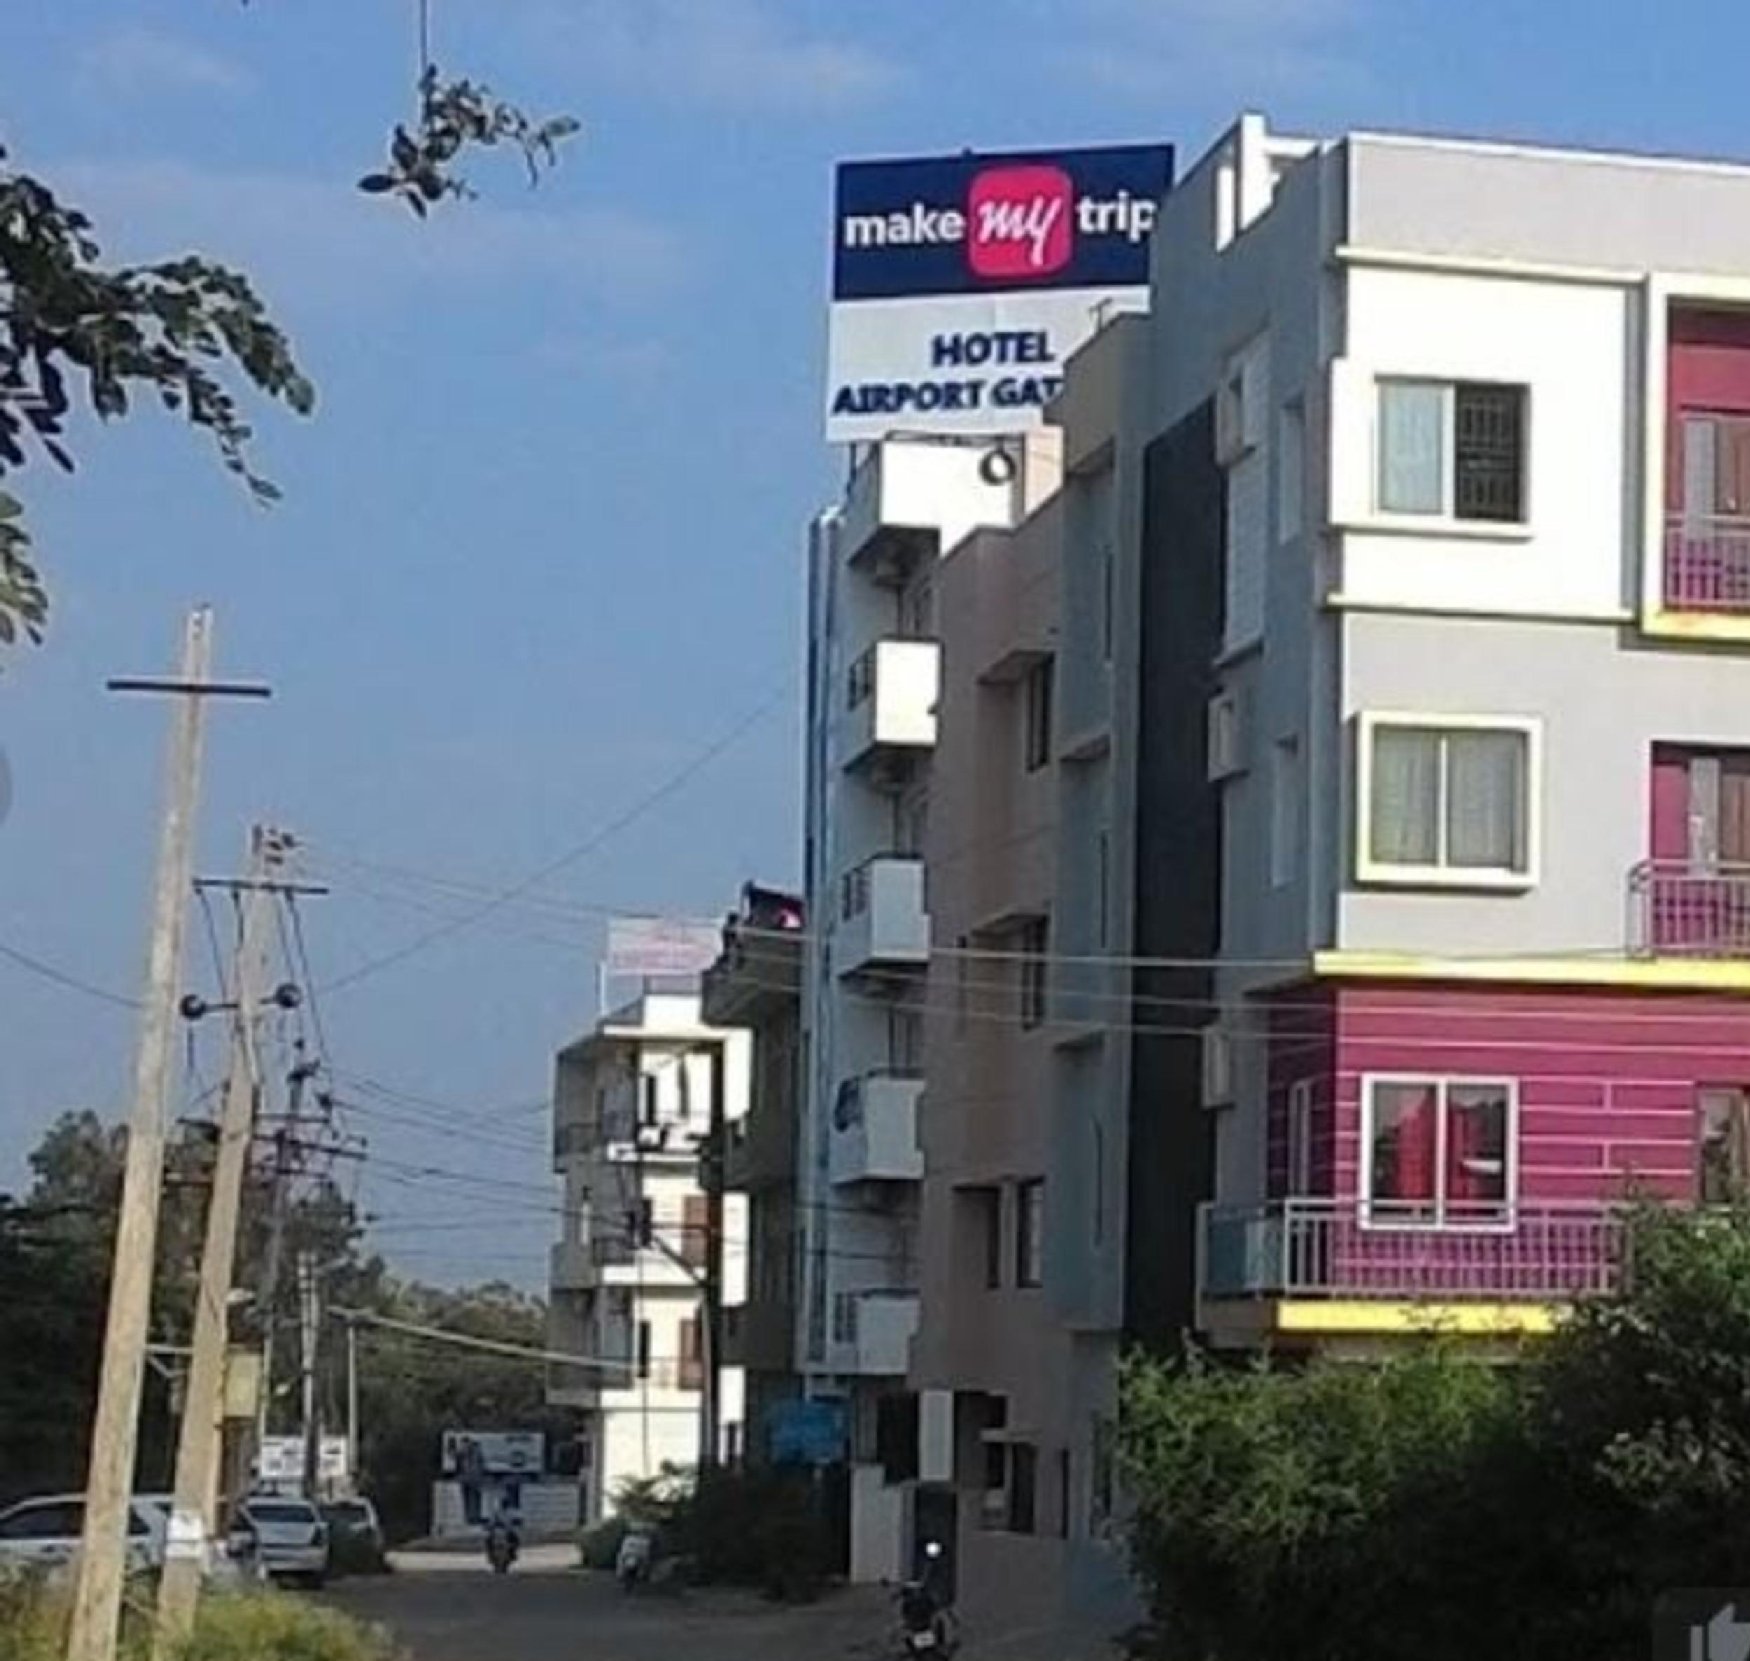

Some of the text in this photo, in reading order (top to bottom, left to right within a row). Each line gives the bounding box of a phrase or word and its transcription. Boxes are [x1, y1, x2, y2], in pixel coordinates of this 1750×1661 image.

[844, 189, 1157, 266] make my trip
[931, 331, 1056, 368] HOTEL
[832, 376, 1062, 415] AIRPORT GAT
